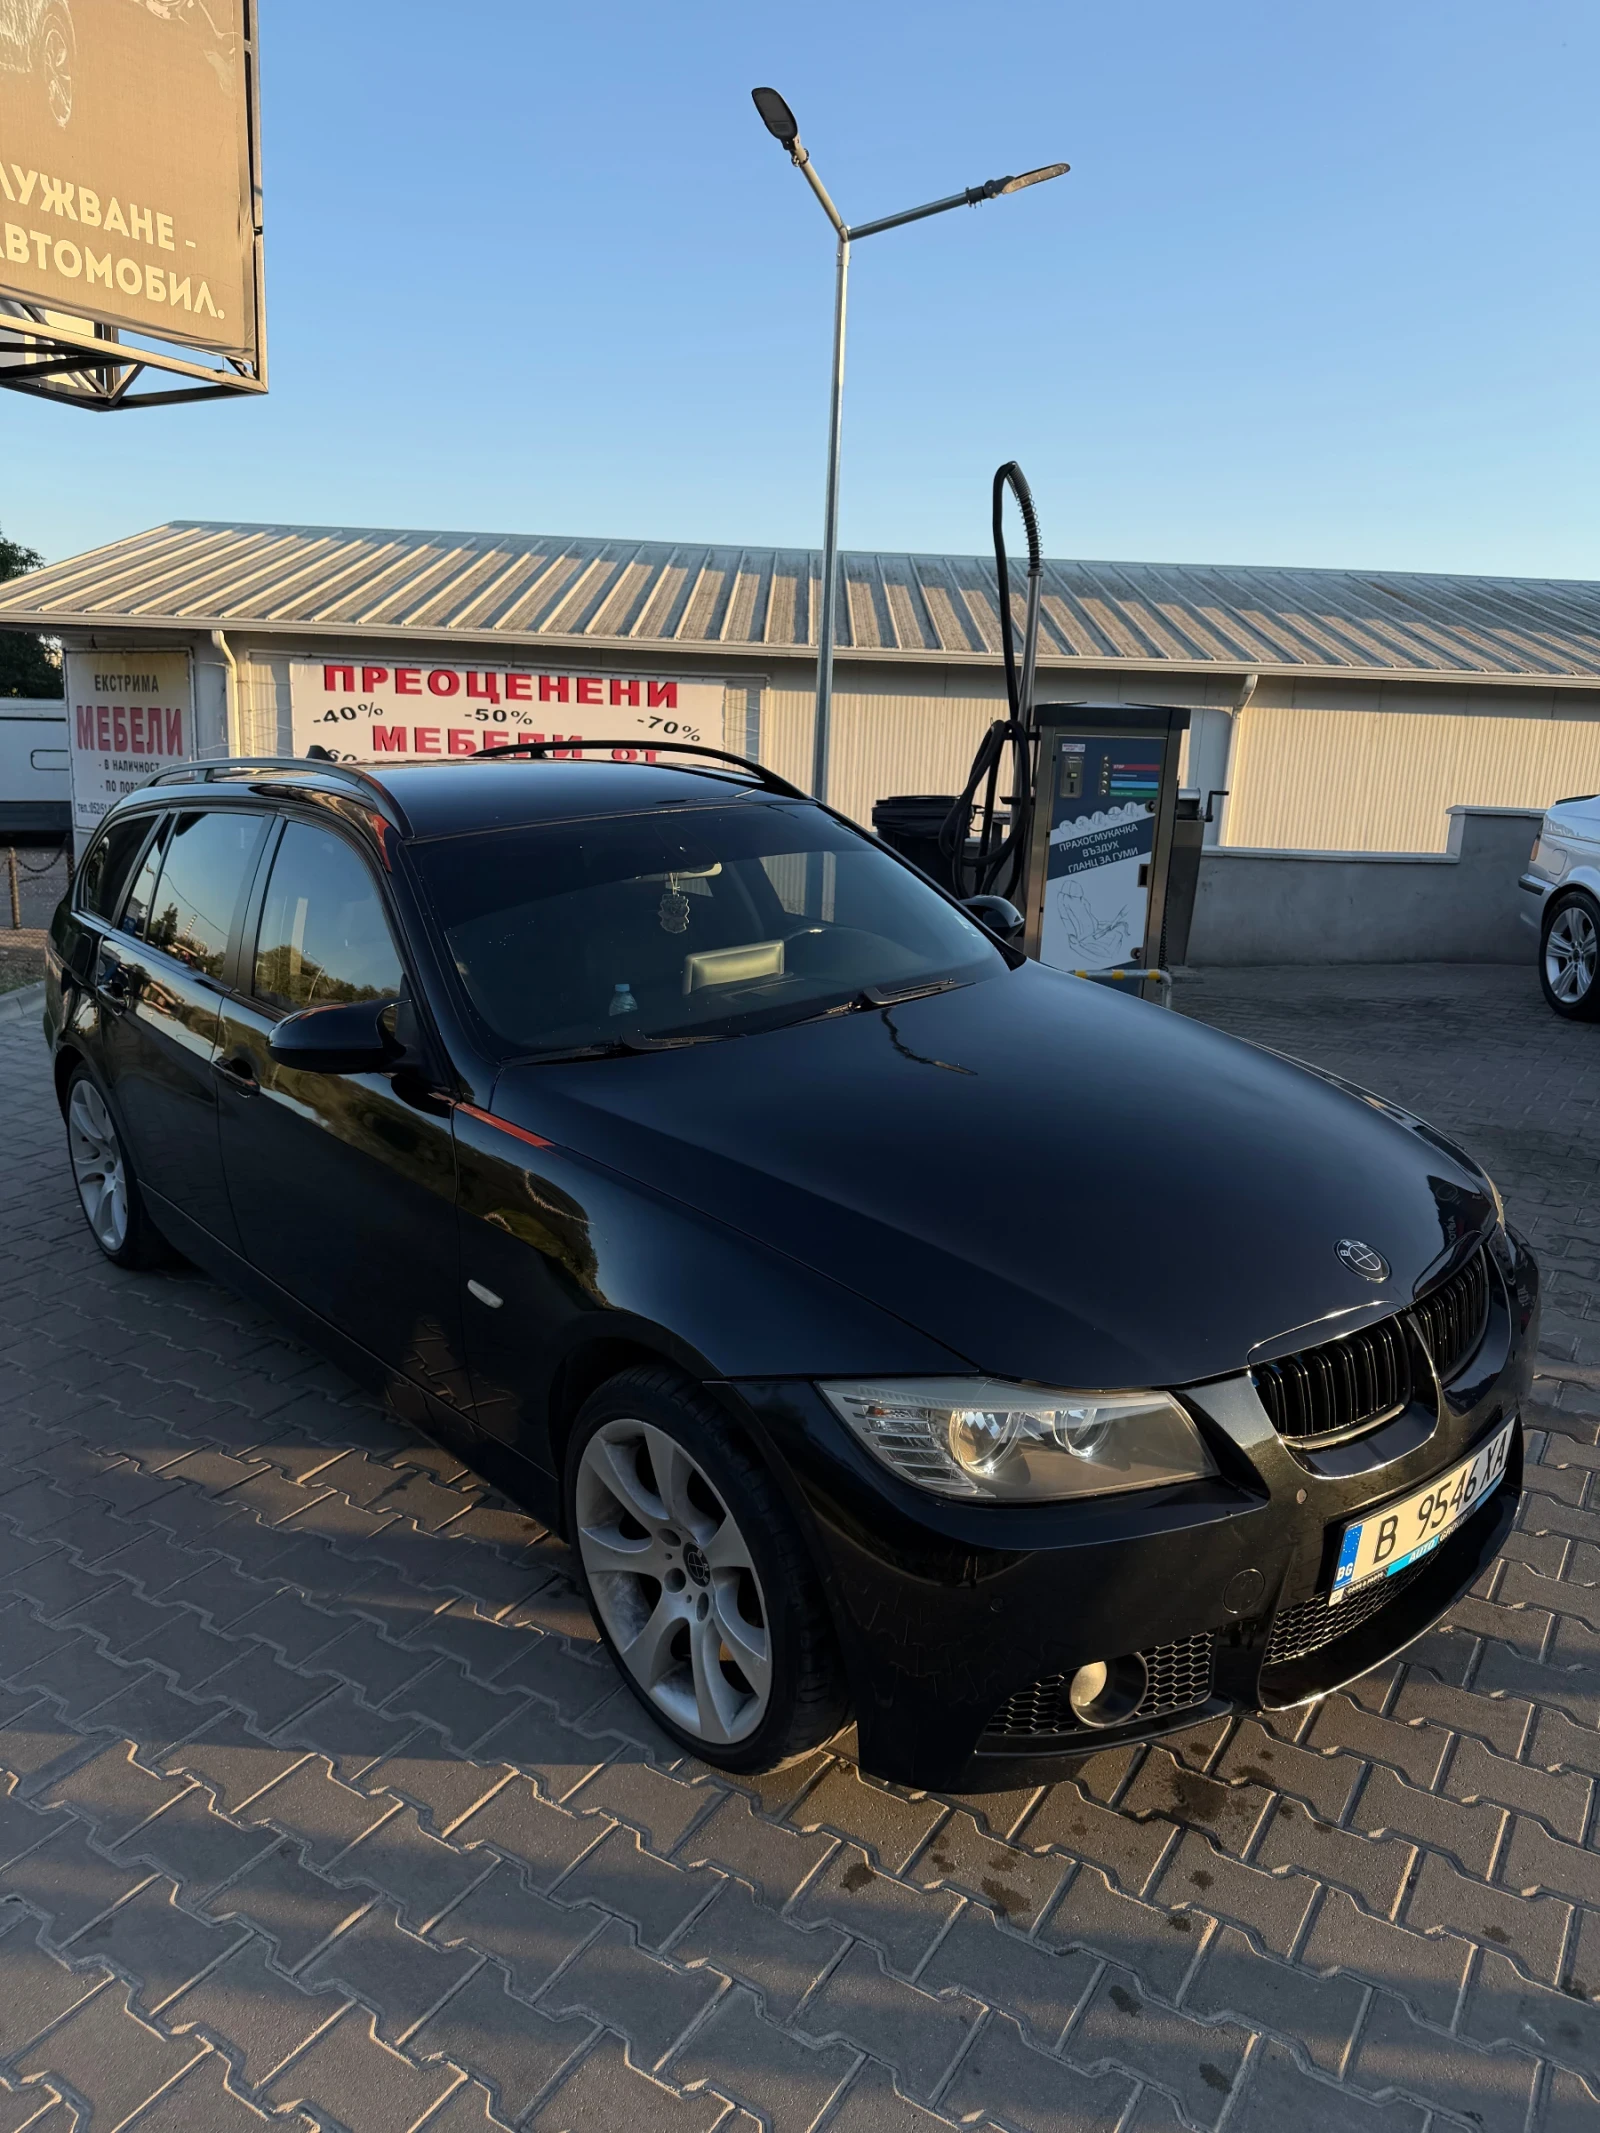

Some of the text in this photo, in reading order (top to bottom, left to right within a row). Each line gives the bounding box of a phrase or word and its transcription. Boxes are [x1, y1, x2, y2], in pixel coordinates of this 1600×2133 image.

[0, 222, 226, 320] ВТОМОБИЛ.
[94, 674, 160, 693] ЕКСТРИМА
[323, 664, 678, 709] ПРЕОЦЕНЕНИ
[76, 705, 184, 757] МЕБЕЛИ
[313, 702, 701, 742] -40% -50% -70%
[104, 759, 110, 770] В
[105, 780, 117, 792] ПО
[1059, 823, 1139, 852] ПРАХОСМУКАЧКА
[1082, 840, 1120, 858] ВЪЗДУХ
[1068, 847, 1139, 874] ГЛАНЦ ЗА ГУМИ
[1416, 1457, 1480, 1541] 9546
[1479, 1430, 1507, 1490] XA
[1408, 1540, 1436, 1563] AUTO
[1337, 1562, 1353, 1581] BG
